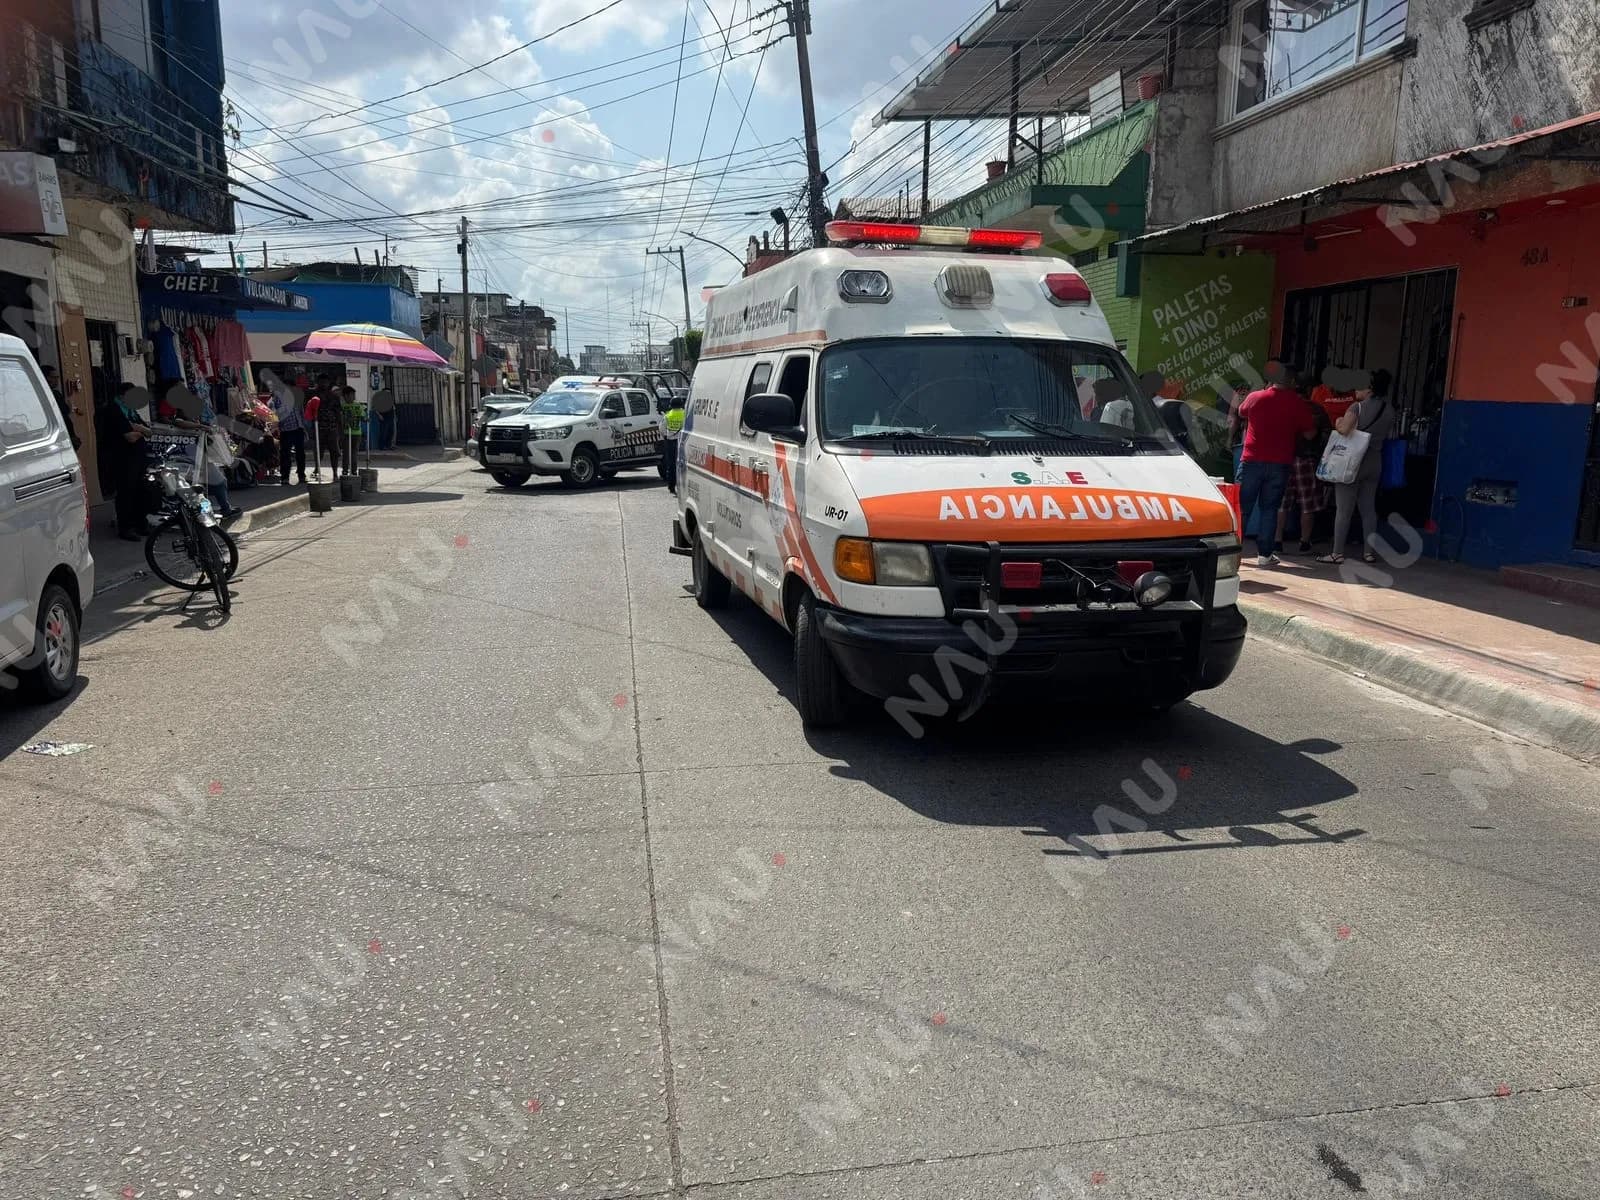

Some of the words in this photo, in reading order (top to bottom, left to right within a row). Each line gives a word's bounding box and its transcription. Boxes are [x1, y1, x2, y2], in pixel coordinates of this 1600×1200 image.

[1152, 274, 1233, 329] PALETAS
[1157, 332, 1222, 375] DELICIOSAS
[1224, 307, 1267, 340] PALETAS
[1172, 309, 1218, 347] DINO
[1203, 346, 1231, 368] AGUA
[825, 505, 848, 521] UR-01
